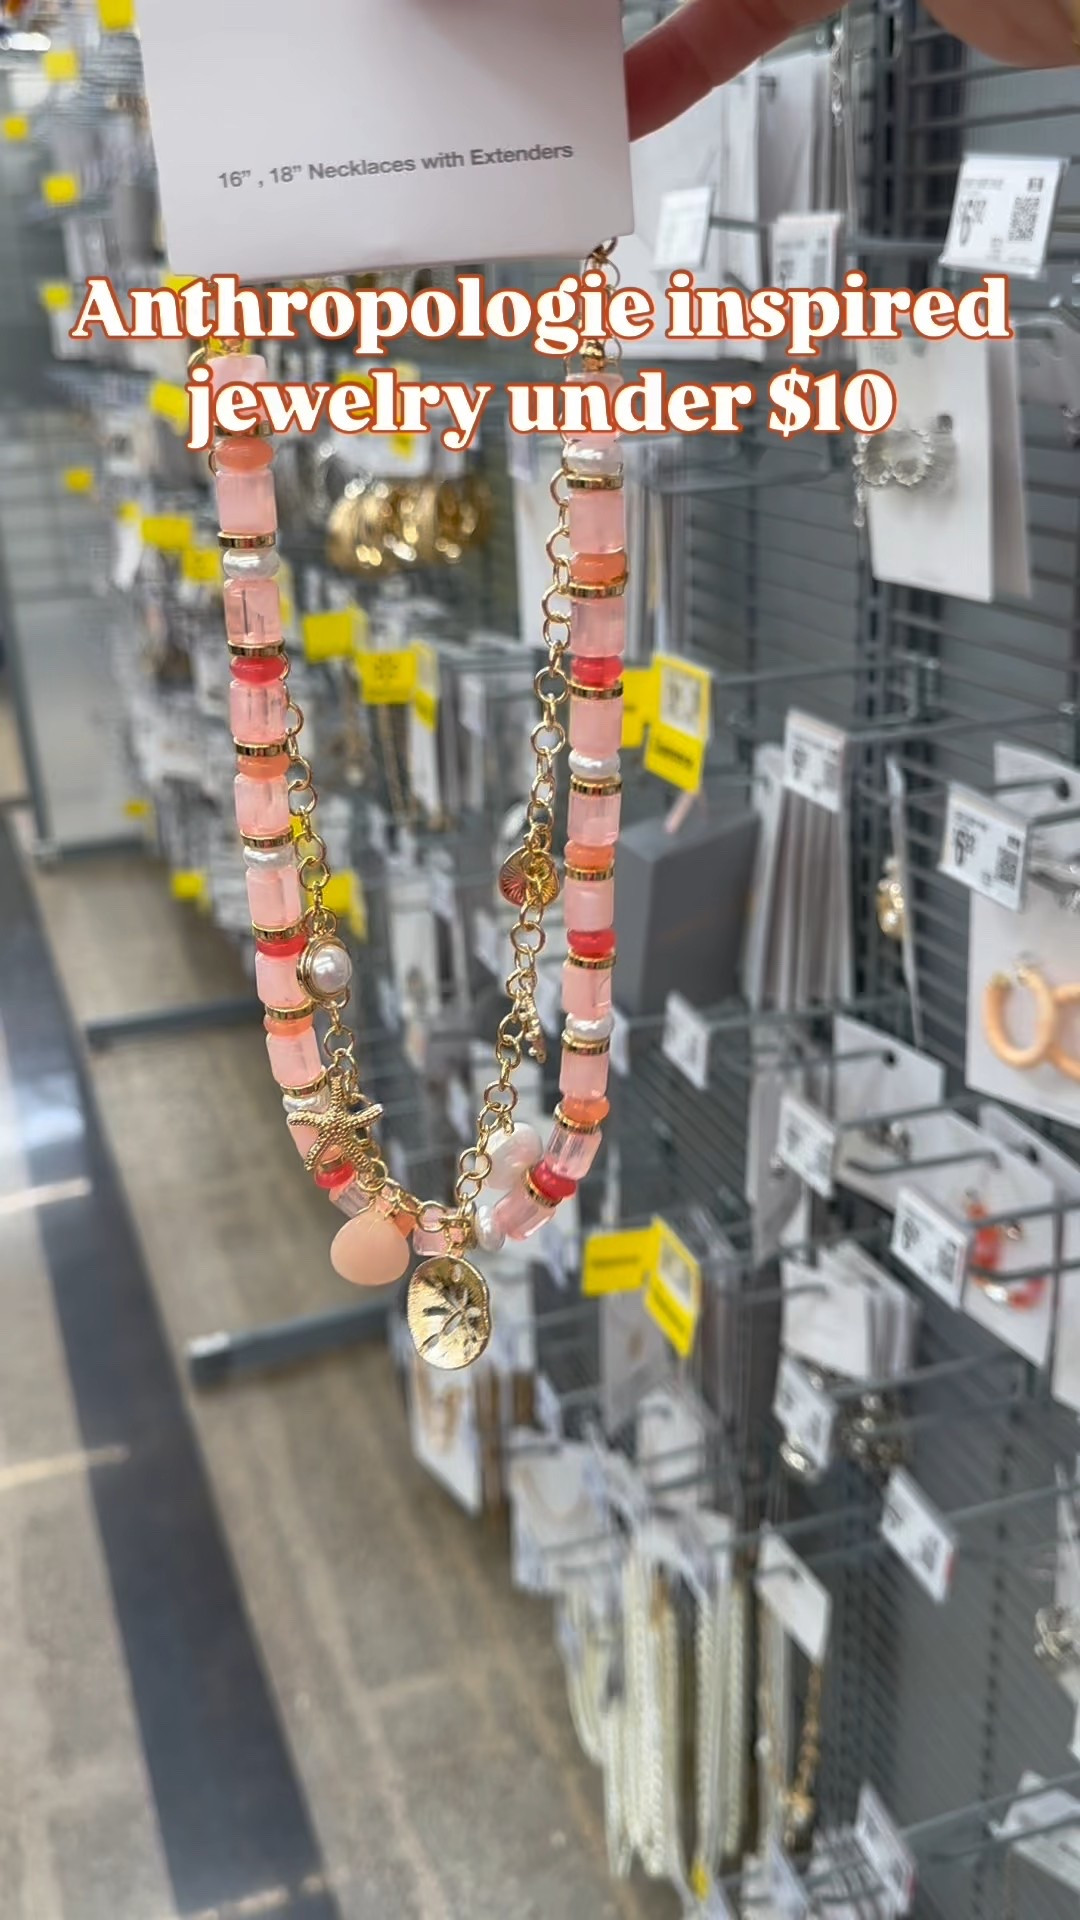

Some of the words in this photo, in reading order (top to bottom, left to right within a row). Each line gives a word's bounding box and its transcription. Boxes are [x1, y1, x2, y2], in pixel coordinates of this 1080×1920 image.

[308, 158, 416, 180] Necklaces
[420, 151, 465, 169] with
[470, 144, 574, 165] Extenders
